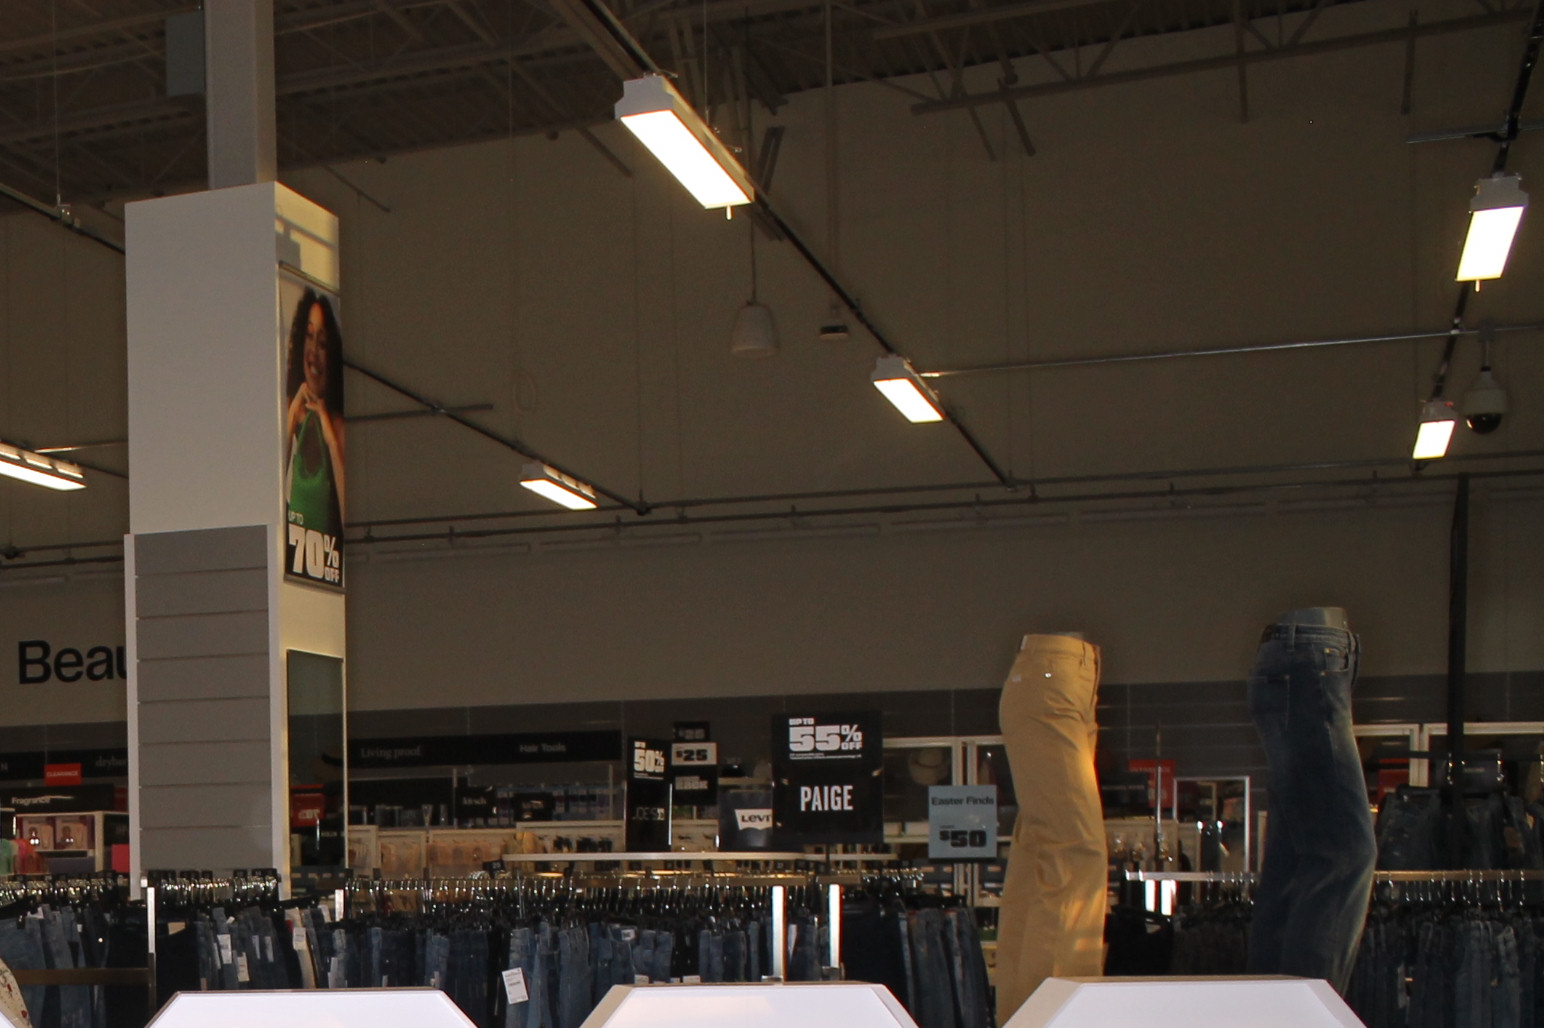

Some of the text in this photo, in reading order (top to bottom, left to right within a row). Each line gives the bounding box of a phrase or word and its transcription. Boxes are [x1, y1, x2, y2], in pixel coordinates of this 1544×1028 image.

[288, 523, 340, 579] 70%
[324, 566, 340, 583] OFF
[789, 725, 862, 752] 55%
[841, 742, 862, 750] OFF
[360, 747, 392, 760] Living
[520, 743, 566, 752] Hair Tools
[676, 749, 708, 762] $25
[800, 785, 853, 811] PAIGE
[931, 796, 994, 806] Easter Finds
[939, 830, 986, 848] $50
